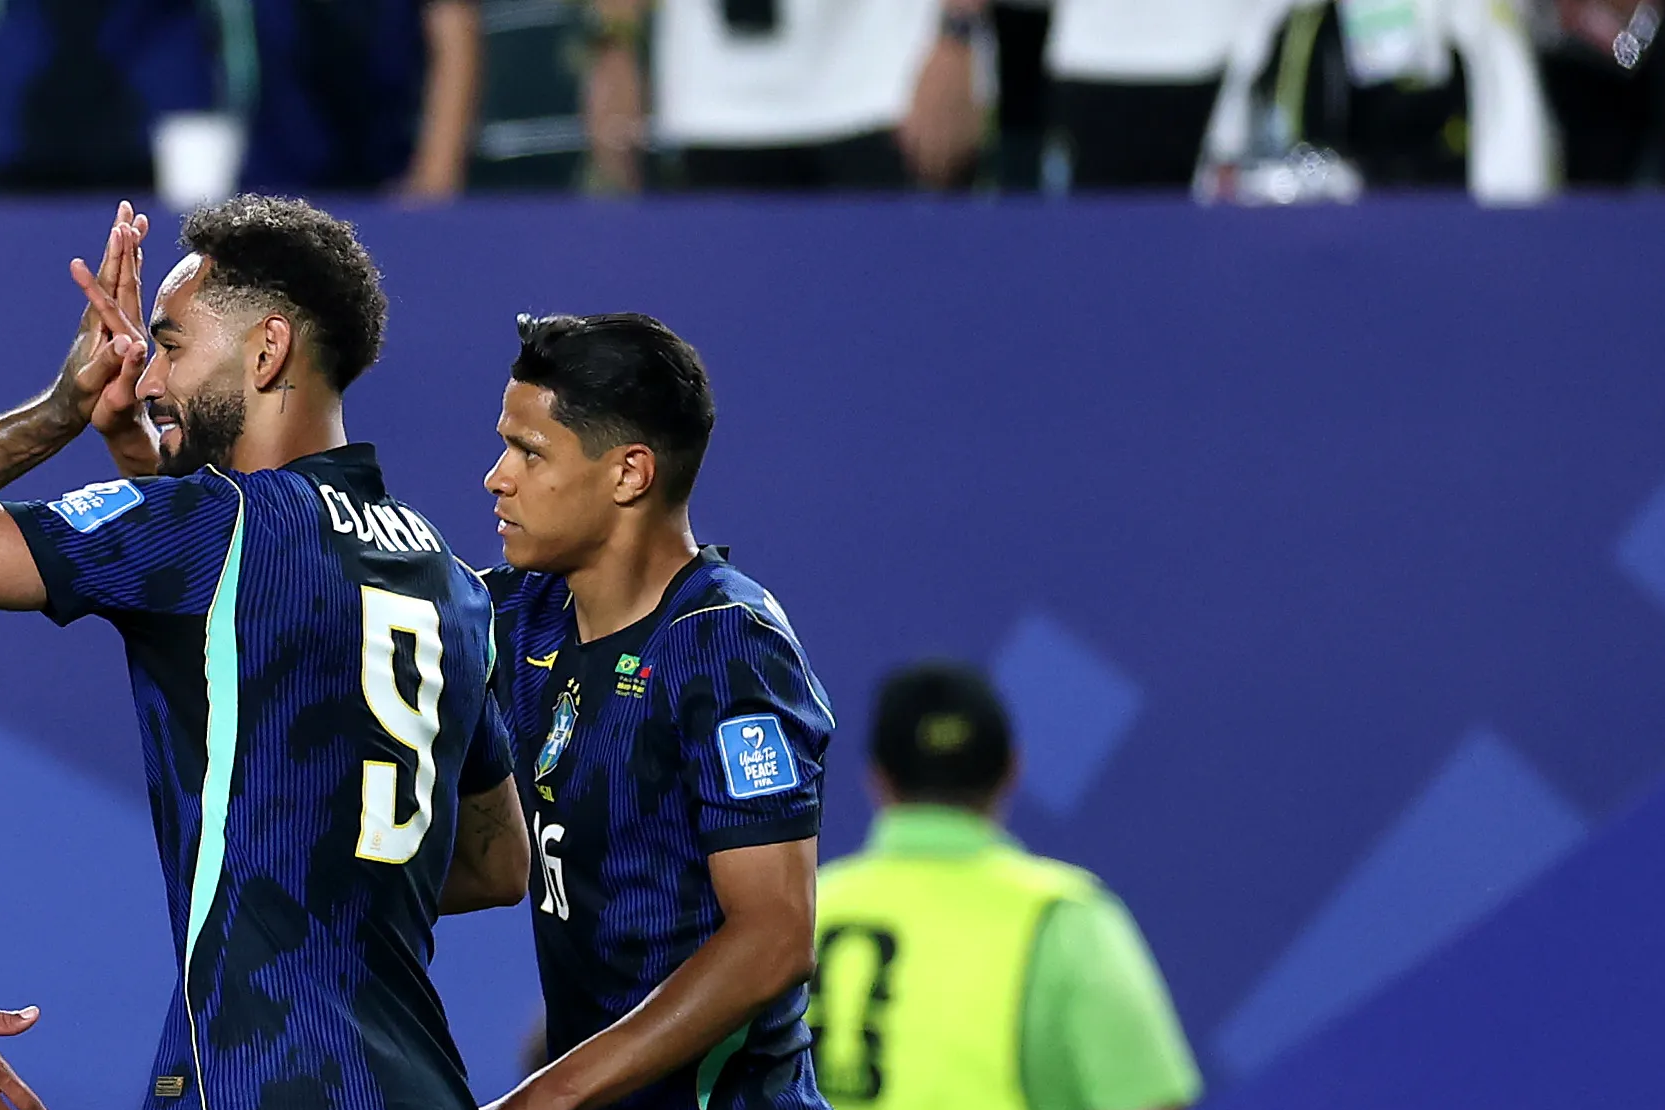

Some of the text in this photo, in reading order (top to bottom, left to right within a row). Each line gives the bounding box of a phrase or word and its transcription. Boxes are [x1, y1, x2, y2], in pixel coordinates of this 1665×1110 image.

[354, 584, 444, 864] 9
[762, 746, 776, 761] For
[744, 761, 778, 781] PEACE
[754, 778, 774, 788] FIFA
[534, 811, 569, 921] 16
